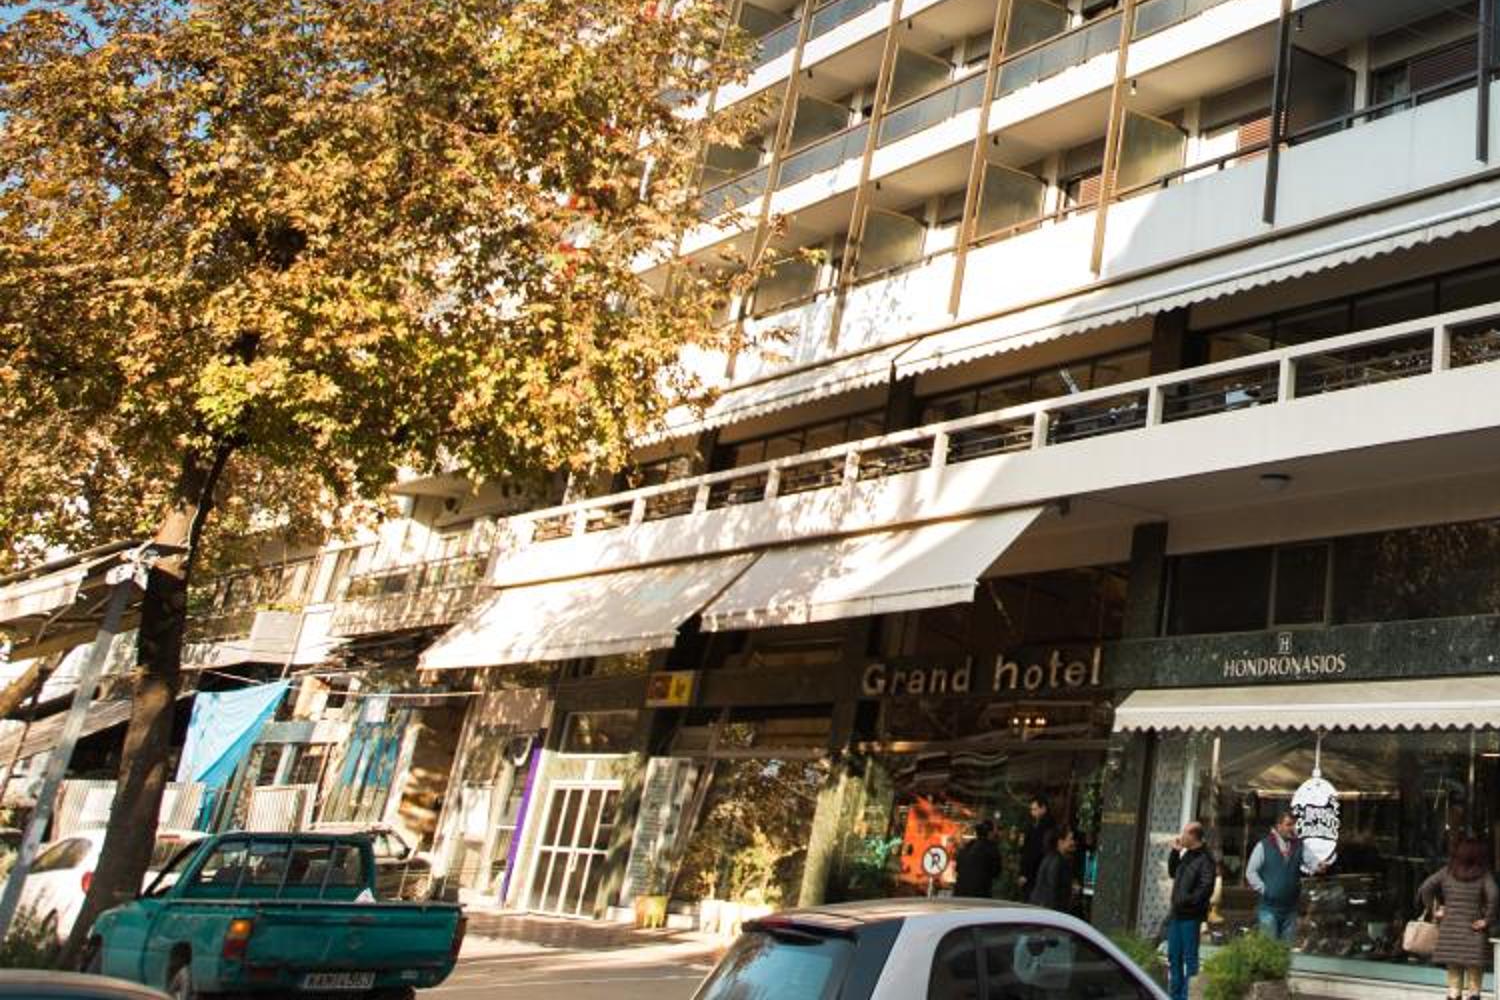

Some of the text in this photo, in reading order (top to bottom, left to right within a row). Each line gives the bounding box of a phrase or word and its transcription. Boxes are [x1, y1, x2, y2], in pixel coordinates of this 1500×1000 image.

[862, 647, 1101, 696] Grand hotel
[1223, 654, 1347, 678] HONDRONASIOS
